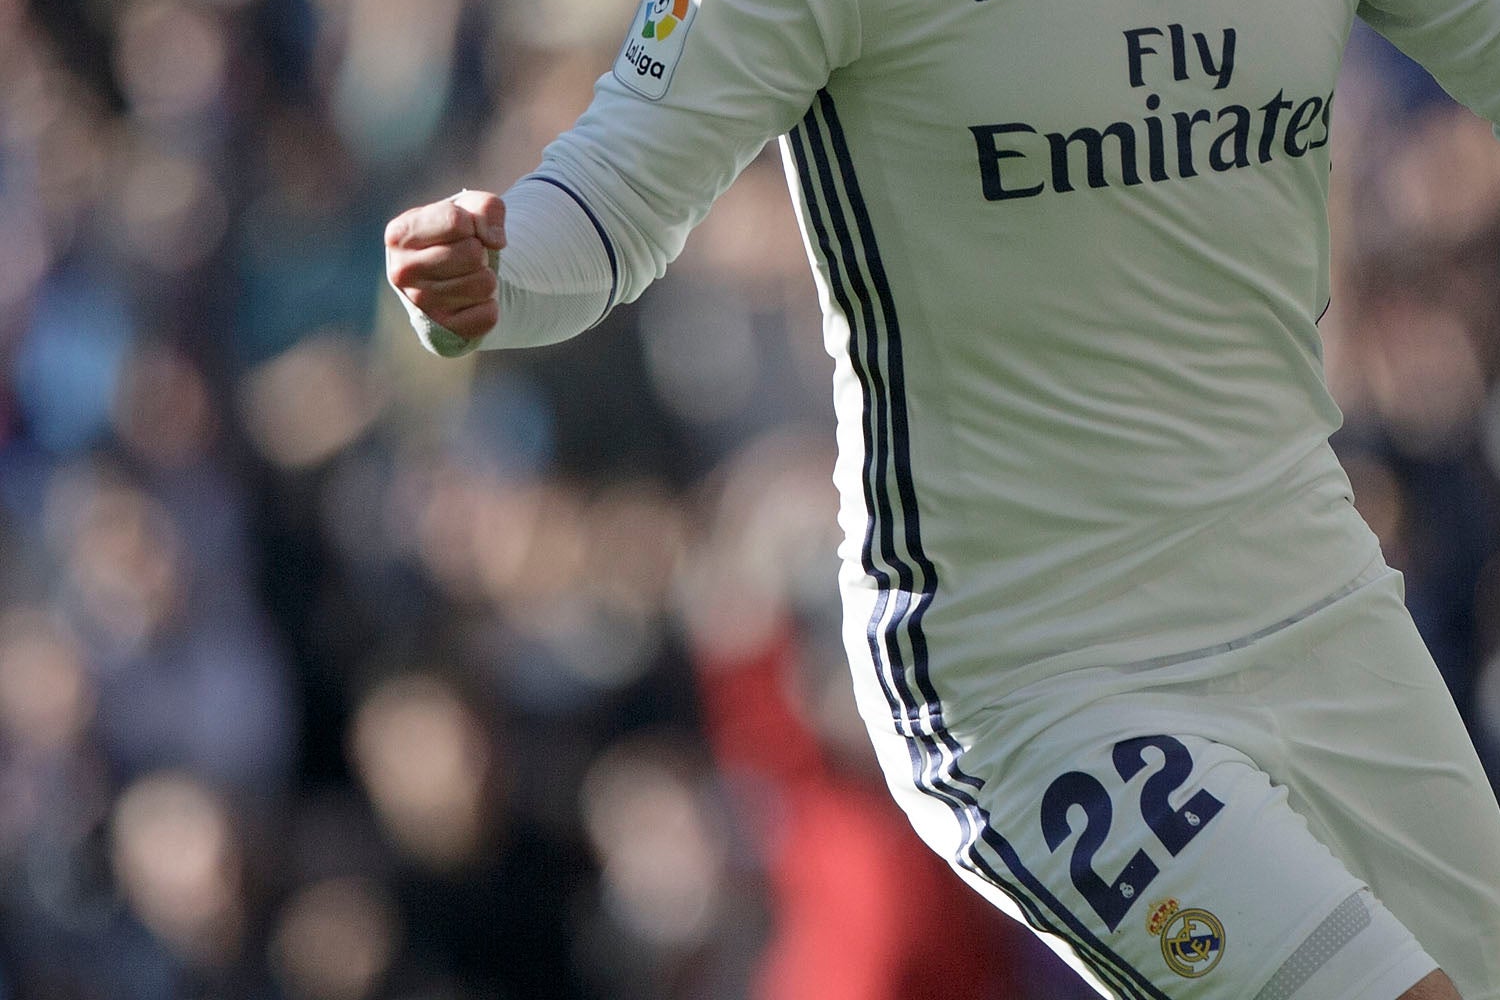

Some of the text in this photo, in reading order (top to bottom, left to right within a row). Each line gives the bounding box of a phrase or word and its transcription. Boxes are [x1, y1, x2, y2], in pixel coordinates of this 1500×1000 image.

[625, 38, 666, 80] LaLiga
[1122, 23, 1237, 90] Fly
[968, 87, 1335, 202] Emirates
[1040, 734, 1225, 933] 22
